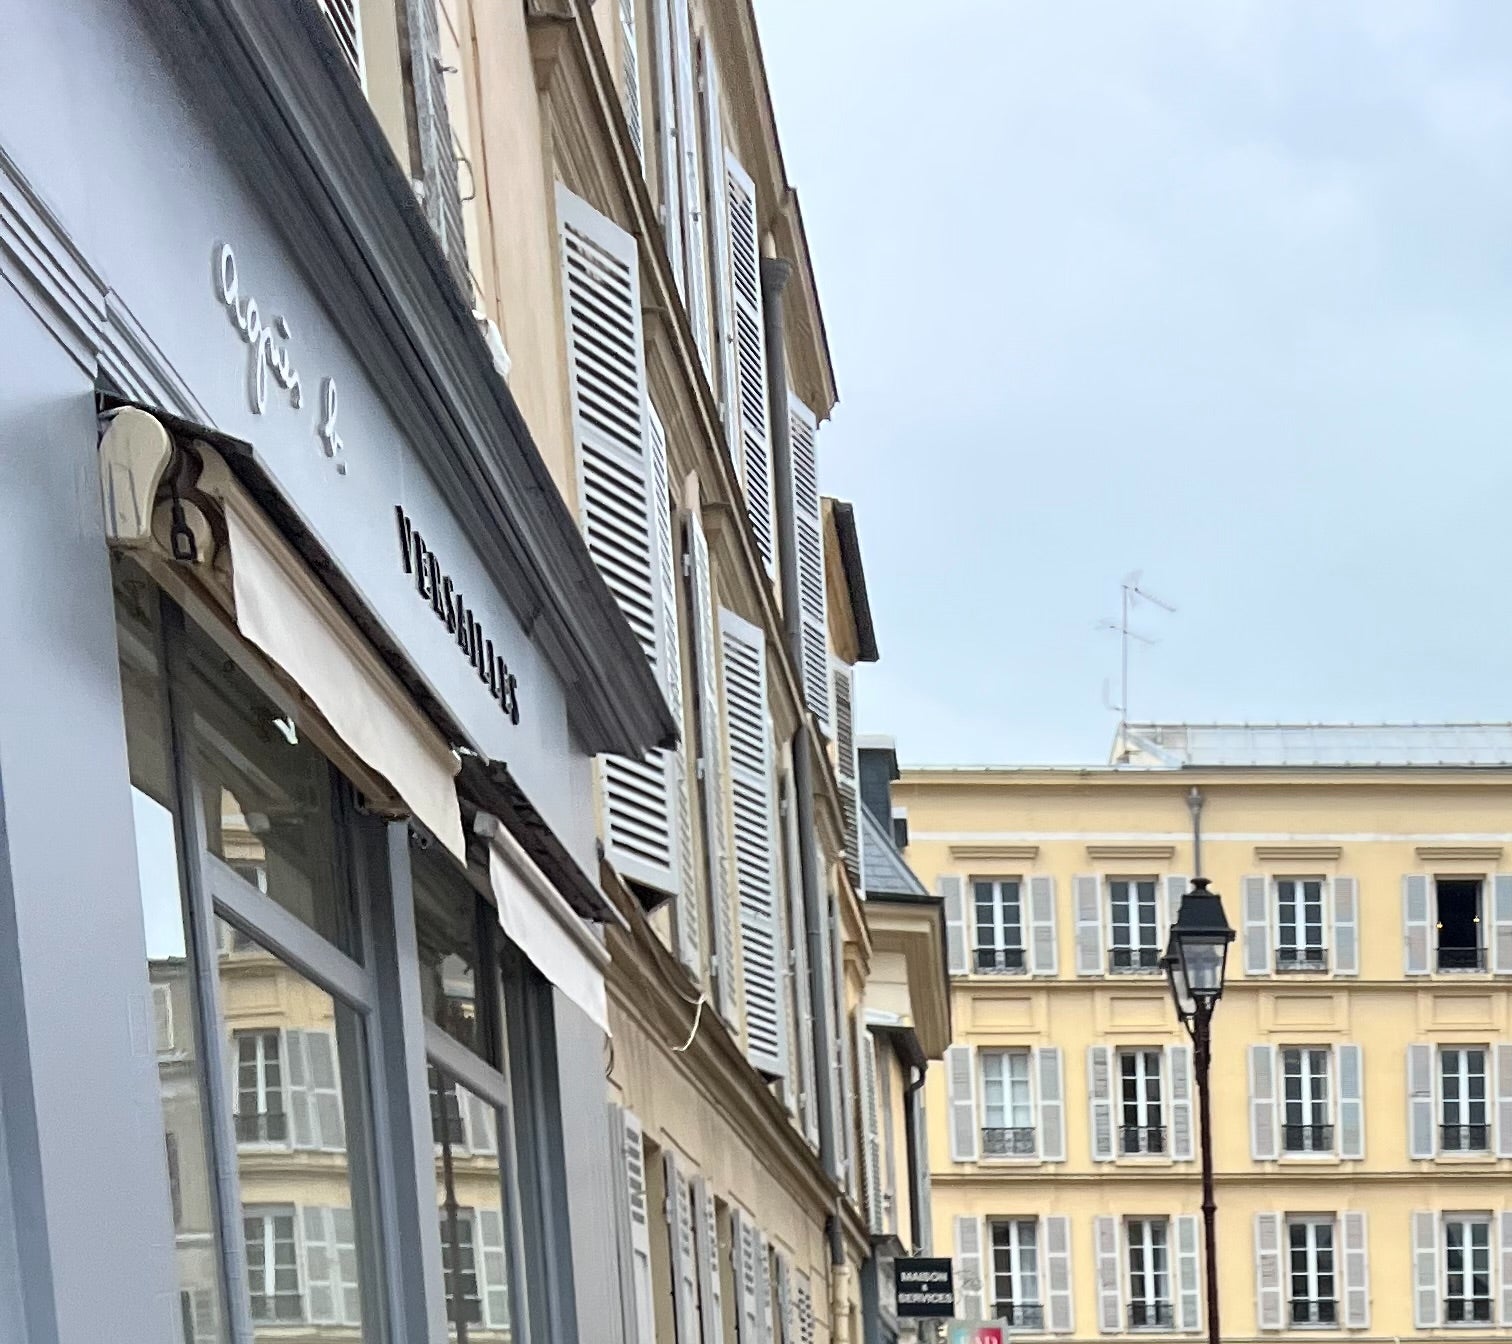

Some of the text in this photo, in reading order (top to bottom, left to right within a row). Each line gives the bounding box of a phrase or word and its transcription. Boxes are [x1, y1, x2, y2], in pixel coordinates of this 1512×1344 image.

[395, 504, 521, 726] VERSAILLES
[900, 1271, 948, 1282] MAISON
[898, 1292, 954, 1304] SERVICES
